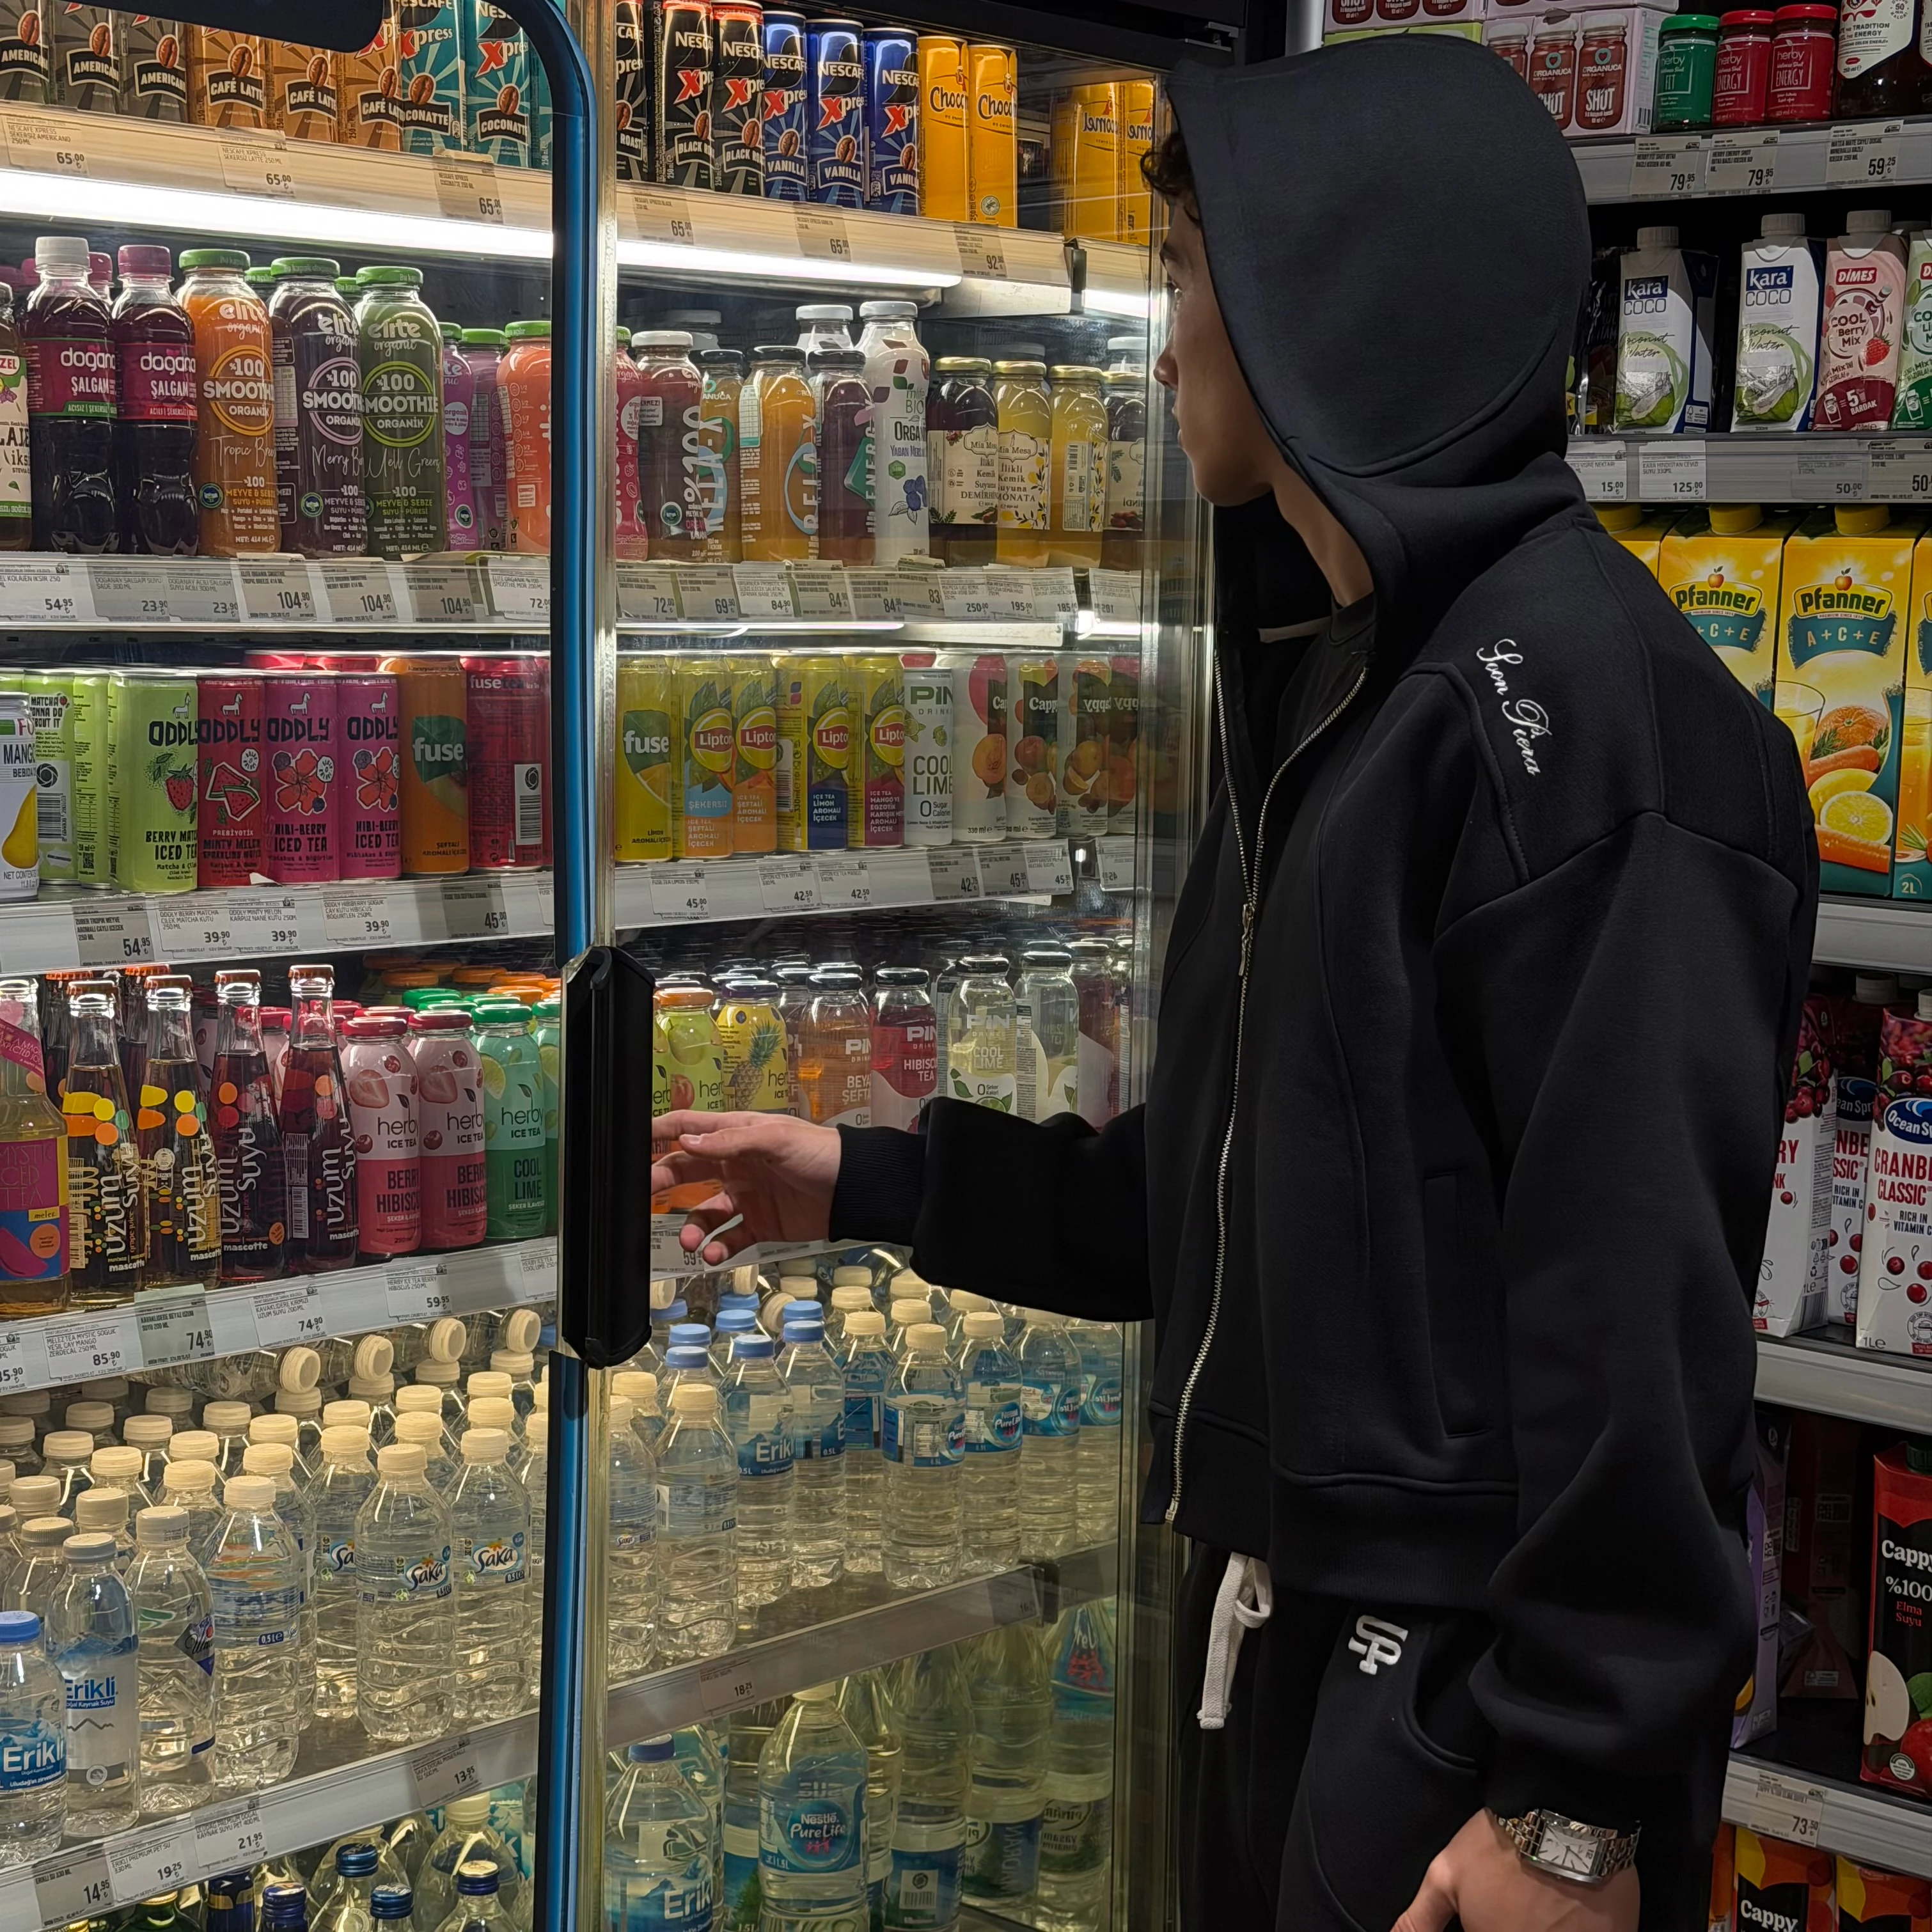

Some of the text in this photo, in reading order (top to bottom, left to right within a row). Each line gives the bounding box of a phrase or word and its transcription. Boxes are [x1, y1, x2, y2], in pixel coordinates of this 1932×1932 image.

[1853, 22, 1890, 31] TRADITION
[1777, 49, 1805, 62] herby
[210, 77, 237, 95] CAFÉ
[1776, 70, 1805, 87] ENERGY
[290, 87, 315, 105] CAFÉ
[362, 97, 386, 114] CAFÉ
[678, 141, 703, 155] BLACK
[726, 148, 751, 162] BLACK
[768, 161, 805, 177] VANILLA
[824, 166, 861, 183] VANILLA
[1749, 270, 1788, 290] kara
[1627, 280, 1664, 299] kara
[1746, 289, 1792, 306] COCO
[1624, 299, 1667, 315] COCO
[1830, 314, 1867, 327] COOL
[368, 320, 421, 339] elite
[1837, 324, 1866, 339] Berry
[1841, 336, 1862, 347] Mix
[230, 357, 263, 377] %100
[72, 377, 109, 395] ŞALGAM
[326, 370, 357, 388] %100
[376, 374, 415, 391] %100
[151, 380, 189, 398] ŞALGAM
[1847, 390, 1859, 409] 5
[1851, 399, 1878, 416] BARDAK
[210, 434, 252, 467] Tropic
[1012, 447, 1032, 455] Mesa
[1676, 585, 1755, 611] pfanner
[1801, 587, 1886, 614] pfanner
[31, 696, 59, 707] MATCHA
[267, 716, 329, 742] ODDLY
[412, 738, 464, 762] fuse
[623, 730, 670, 754] fuse
[933, 801, 948, 810] Sugar
[146, 830, 178, 844] BERRY
[274, 836, 327, 852] ICED TEA
[356, 833, 381, 849] ICED
[155, 844, 182, 861] ICED
[1901, 881, 1917, 895] 2L
[973, 1047, 1004, 1058] COOL
[973, 1057, 1003, 1069] LIME
[918, 1071, 934, 1082] TEA
[501, 1106, 544, 1127] herby
[1888, 1111, 1920, 1135] Ocean
[457, 1134, 470, 1144] ICE
[511, 1127, 541, 1139] ICE TEA
[387, 1139, 418, 1149] ICE TEA
[514, 1158, 542, 1177] COOL
[2, 1186, 44, 1207] TEA
[514, 1180, 542, 1200] LIME
[1834, 1184, 1859, 1198] RICH IN
[1878, 1178, 1927, 1206] CLASSIC
[1899, 1210, 1928, 1224] RICH IN
[1893, 1220, 1925, 1235] VITAMIN
[224, 1241, 269, 1252] mascotte
[475, 1547, 514, 1573] Saka
[408, 1562, 444, 1591] Saka
[1896, 1601, 1922, 1616] Elma
[1896, 1612, 1922, 1628] Suyu
[1741, 1899, 1799, 1932] Cappy
